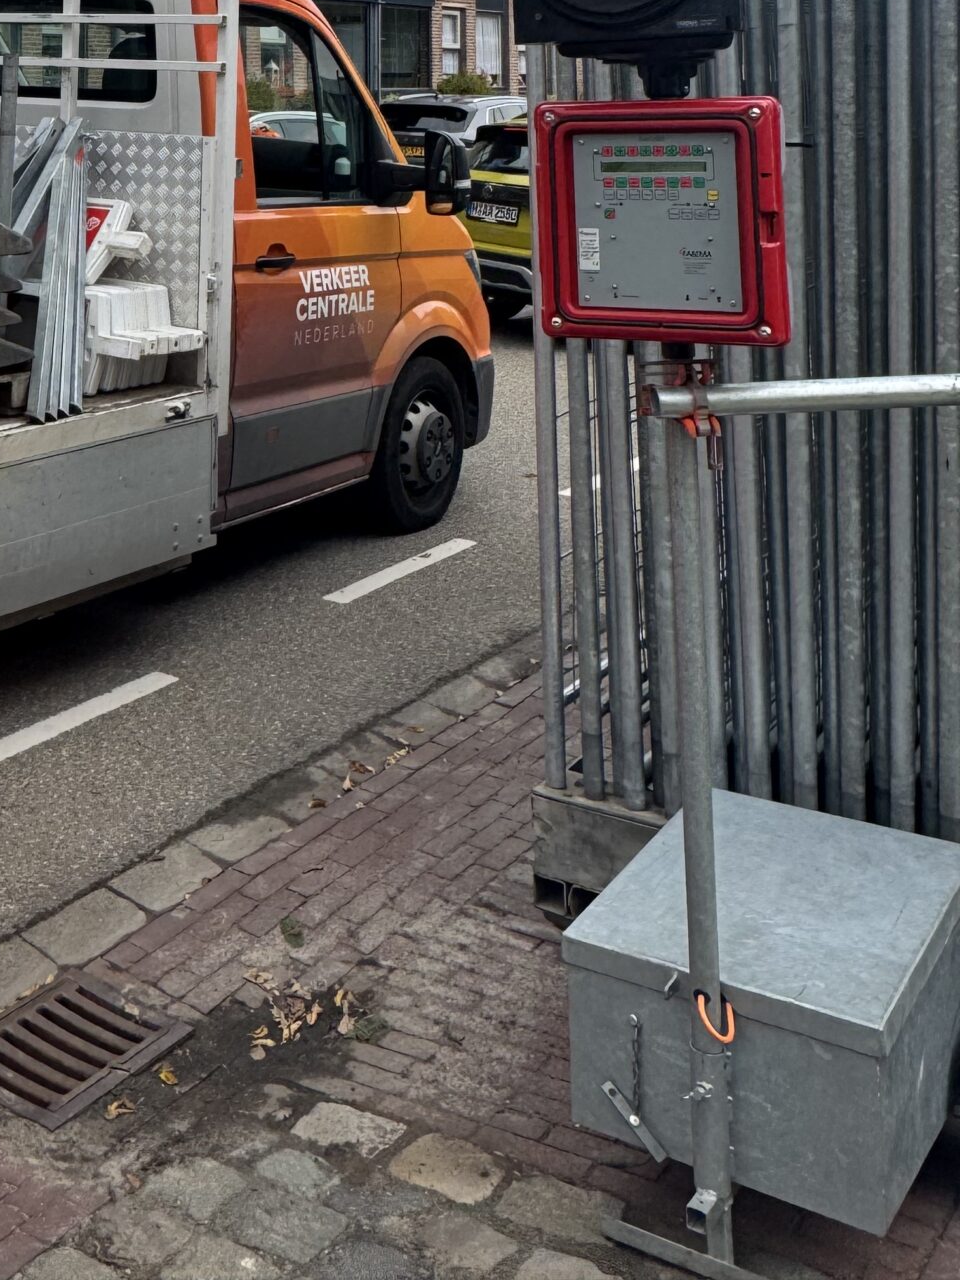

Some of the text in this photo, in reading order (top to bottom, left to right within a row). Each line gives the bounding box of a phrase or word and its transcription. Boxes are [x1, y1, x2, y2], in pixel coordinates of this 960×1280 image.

[298, 264, 370, 294] VERKEER
[295, 290, 375, 322] CENTRALE
[293, 319, 374, 347] NEDERLAND
